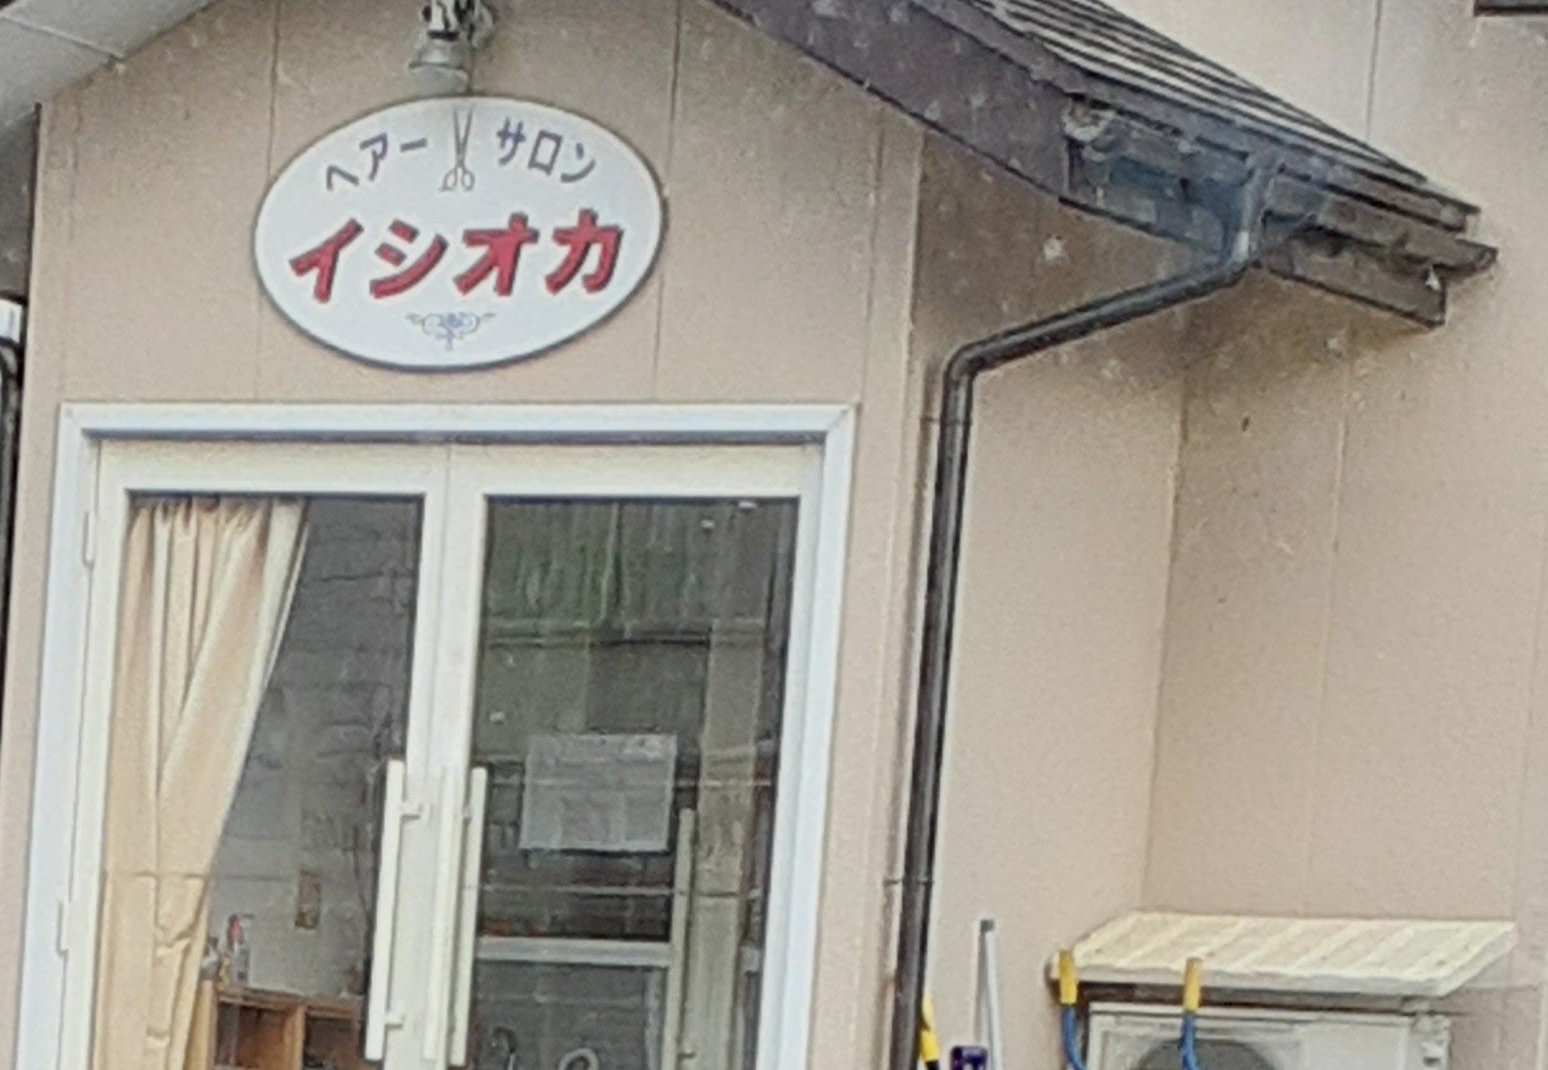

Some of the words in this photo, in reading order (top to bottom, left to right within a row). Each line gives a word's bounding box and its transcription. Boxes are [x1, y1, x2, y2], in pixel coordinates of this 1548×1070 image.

[325, 131, 428, 191] ヘアー
[496, 116, 596, 183] サロン
[289, 207, 625, 304] イシオカ
